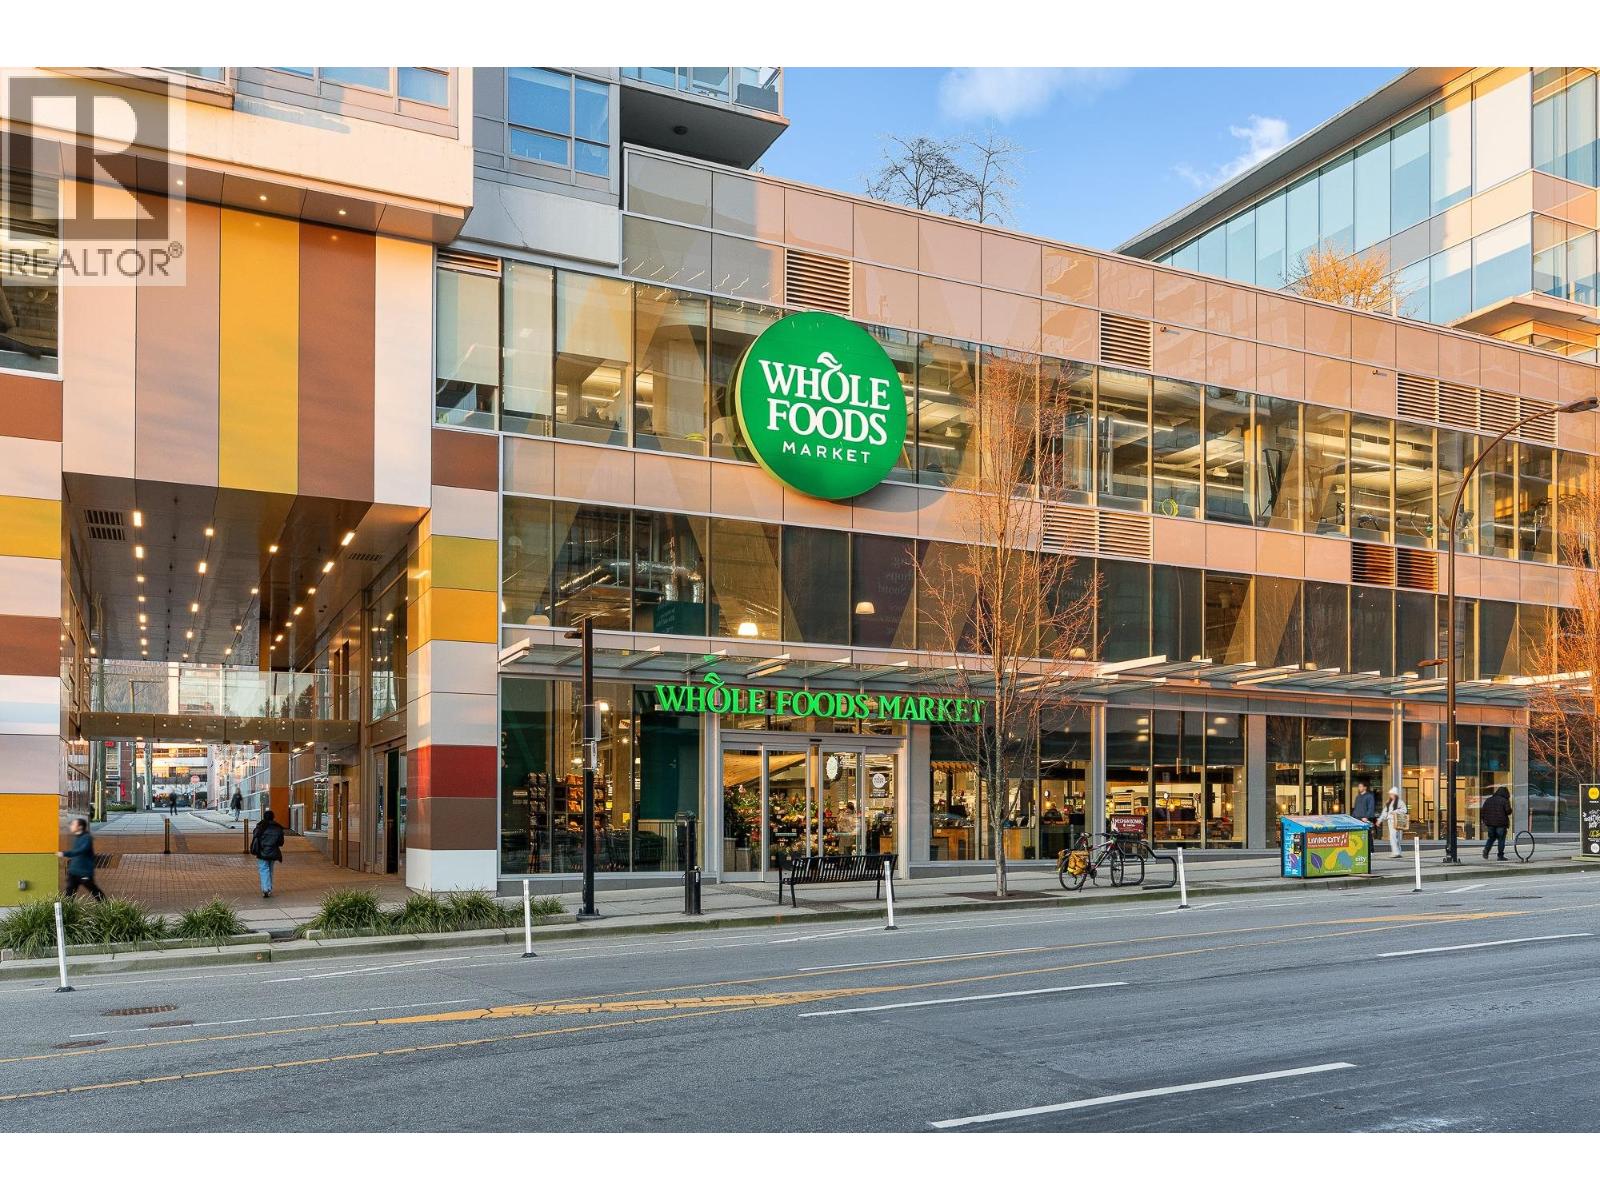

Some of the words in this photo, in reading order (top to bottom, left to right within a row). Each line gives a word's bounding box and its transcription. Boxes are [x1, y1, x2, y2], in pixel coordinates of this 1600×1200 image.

[758, 354, 890, 411] WHOLE
[766, 398, 888, 446] FOODS
[782, 441, 871, 464] MARKET
[654, 677, 766, 715] WHOLE
[775, 690, 870, 720] FOODS
[877, 696, 984, 724] MARKET
